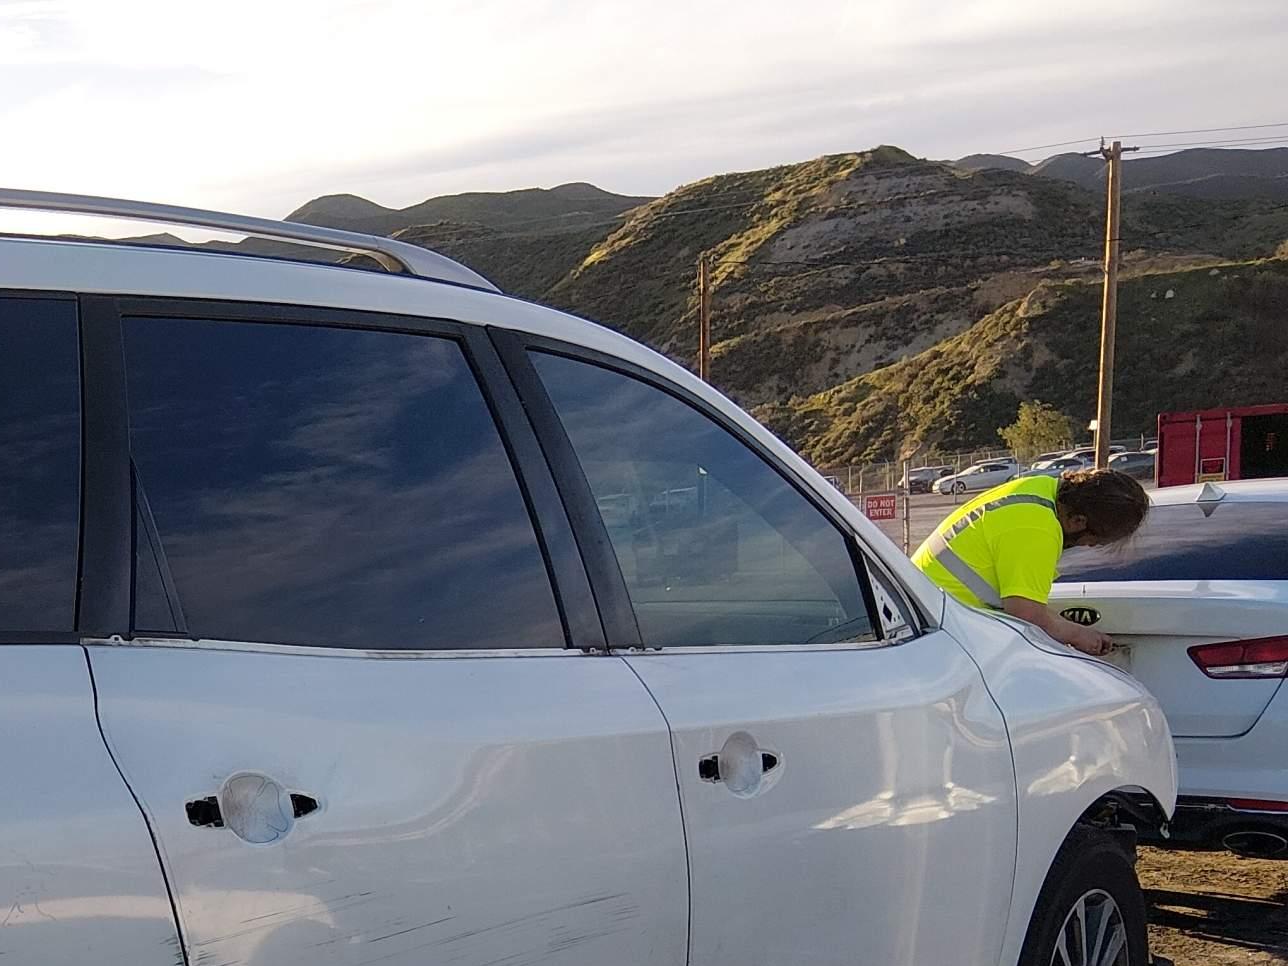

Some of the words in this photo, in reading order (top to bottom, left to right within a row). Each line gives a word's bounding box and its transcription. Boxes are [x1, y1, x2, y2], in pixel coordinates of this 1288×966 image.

[868, 500, 878, 508] DO
[879, 499, 895, 508] NOT
[869, 508, 893, 517] ENTER
[1063, 610, 1092, 623] KIA
